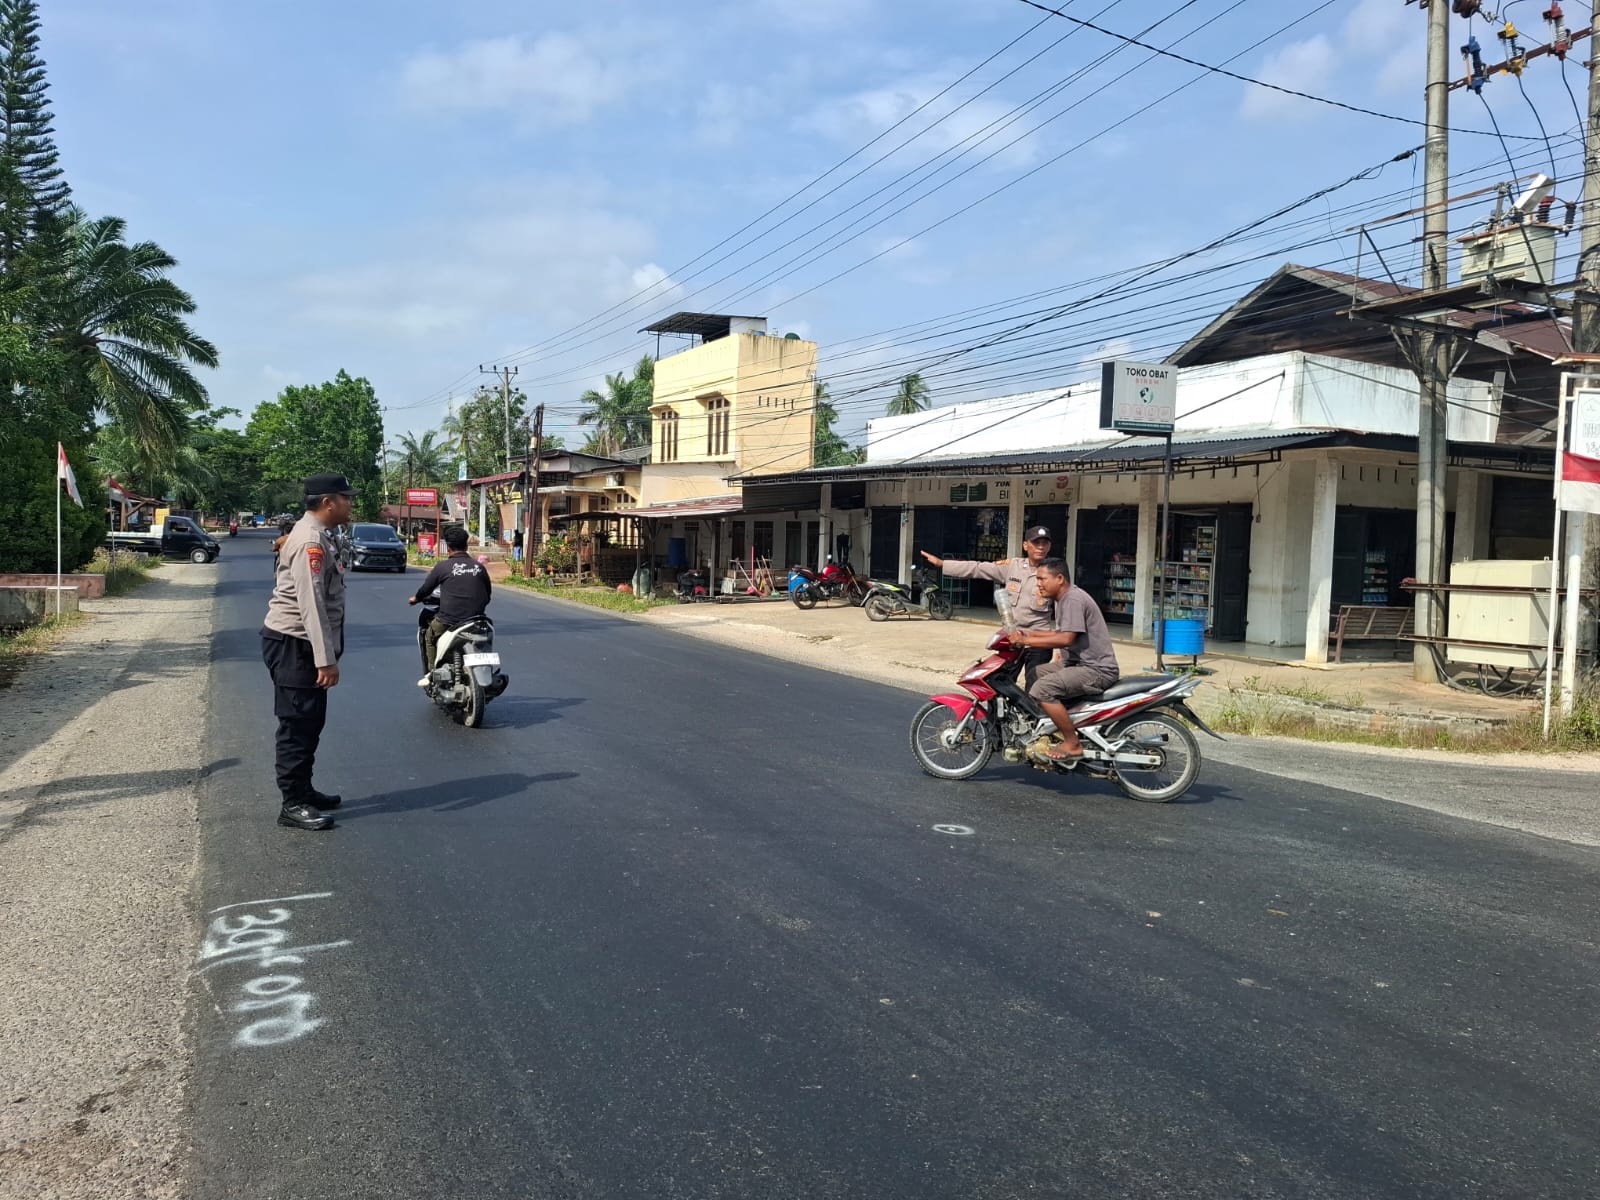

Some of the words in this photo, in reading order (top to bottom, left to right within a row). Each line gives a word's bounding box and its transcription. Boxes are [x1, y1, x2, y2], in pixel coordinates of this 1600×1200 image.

[1126, 367, 1147, 377] TOKO
[1149, 369, 1168, 380] OBAT
[994, 480, 1011, 488] TOK
[999, 488, 1034, 500] BIM
